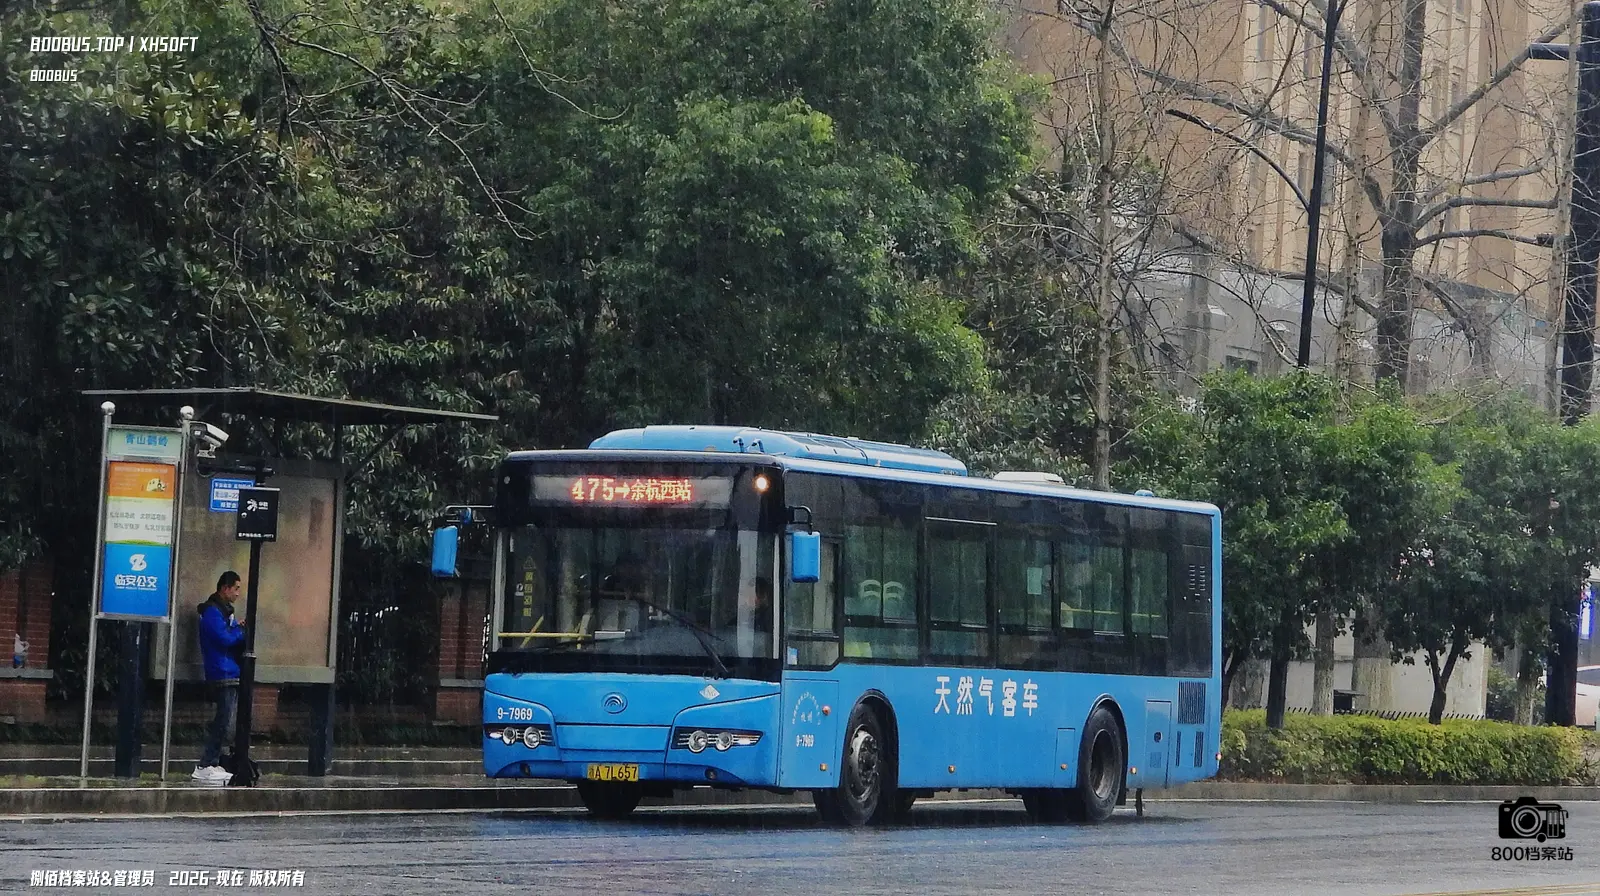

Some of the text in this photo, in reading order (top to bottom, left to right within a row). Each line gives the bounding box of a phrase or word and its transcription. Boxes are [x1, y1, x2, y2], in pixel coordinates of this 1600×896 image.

[572, 477, 692, 502] 475 余杭西站
[115, 574, 158, 588] 临安公交
[934, 676, 1039, 717] 天然气客车
[497, 707, 533, 721] 9-7969
